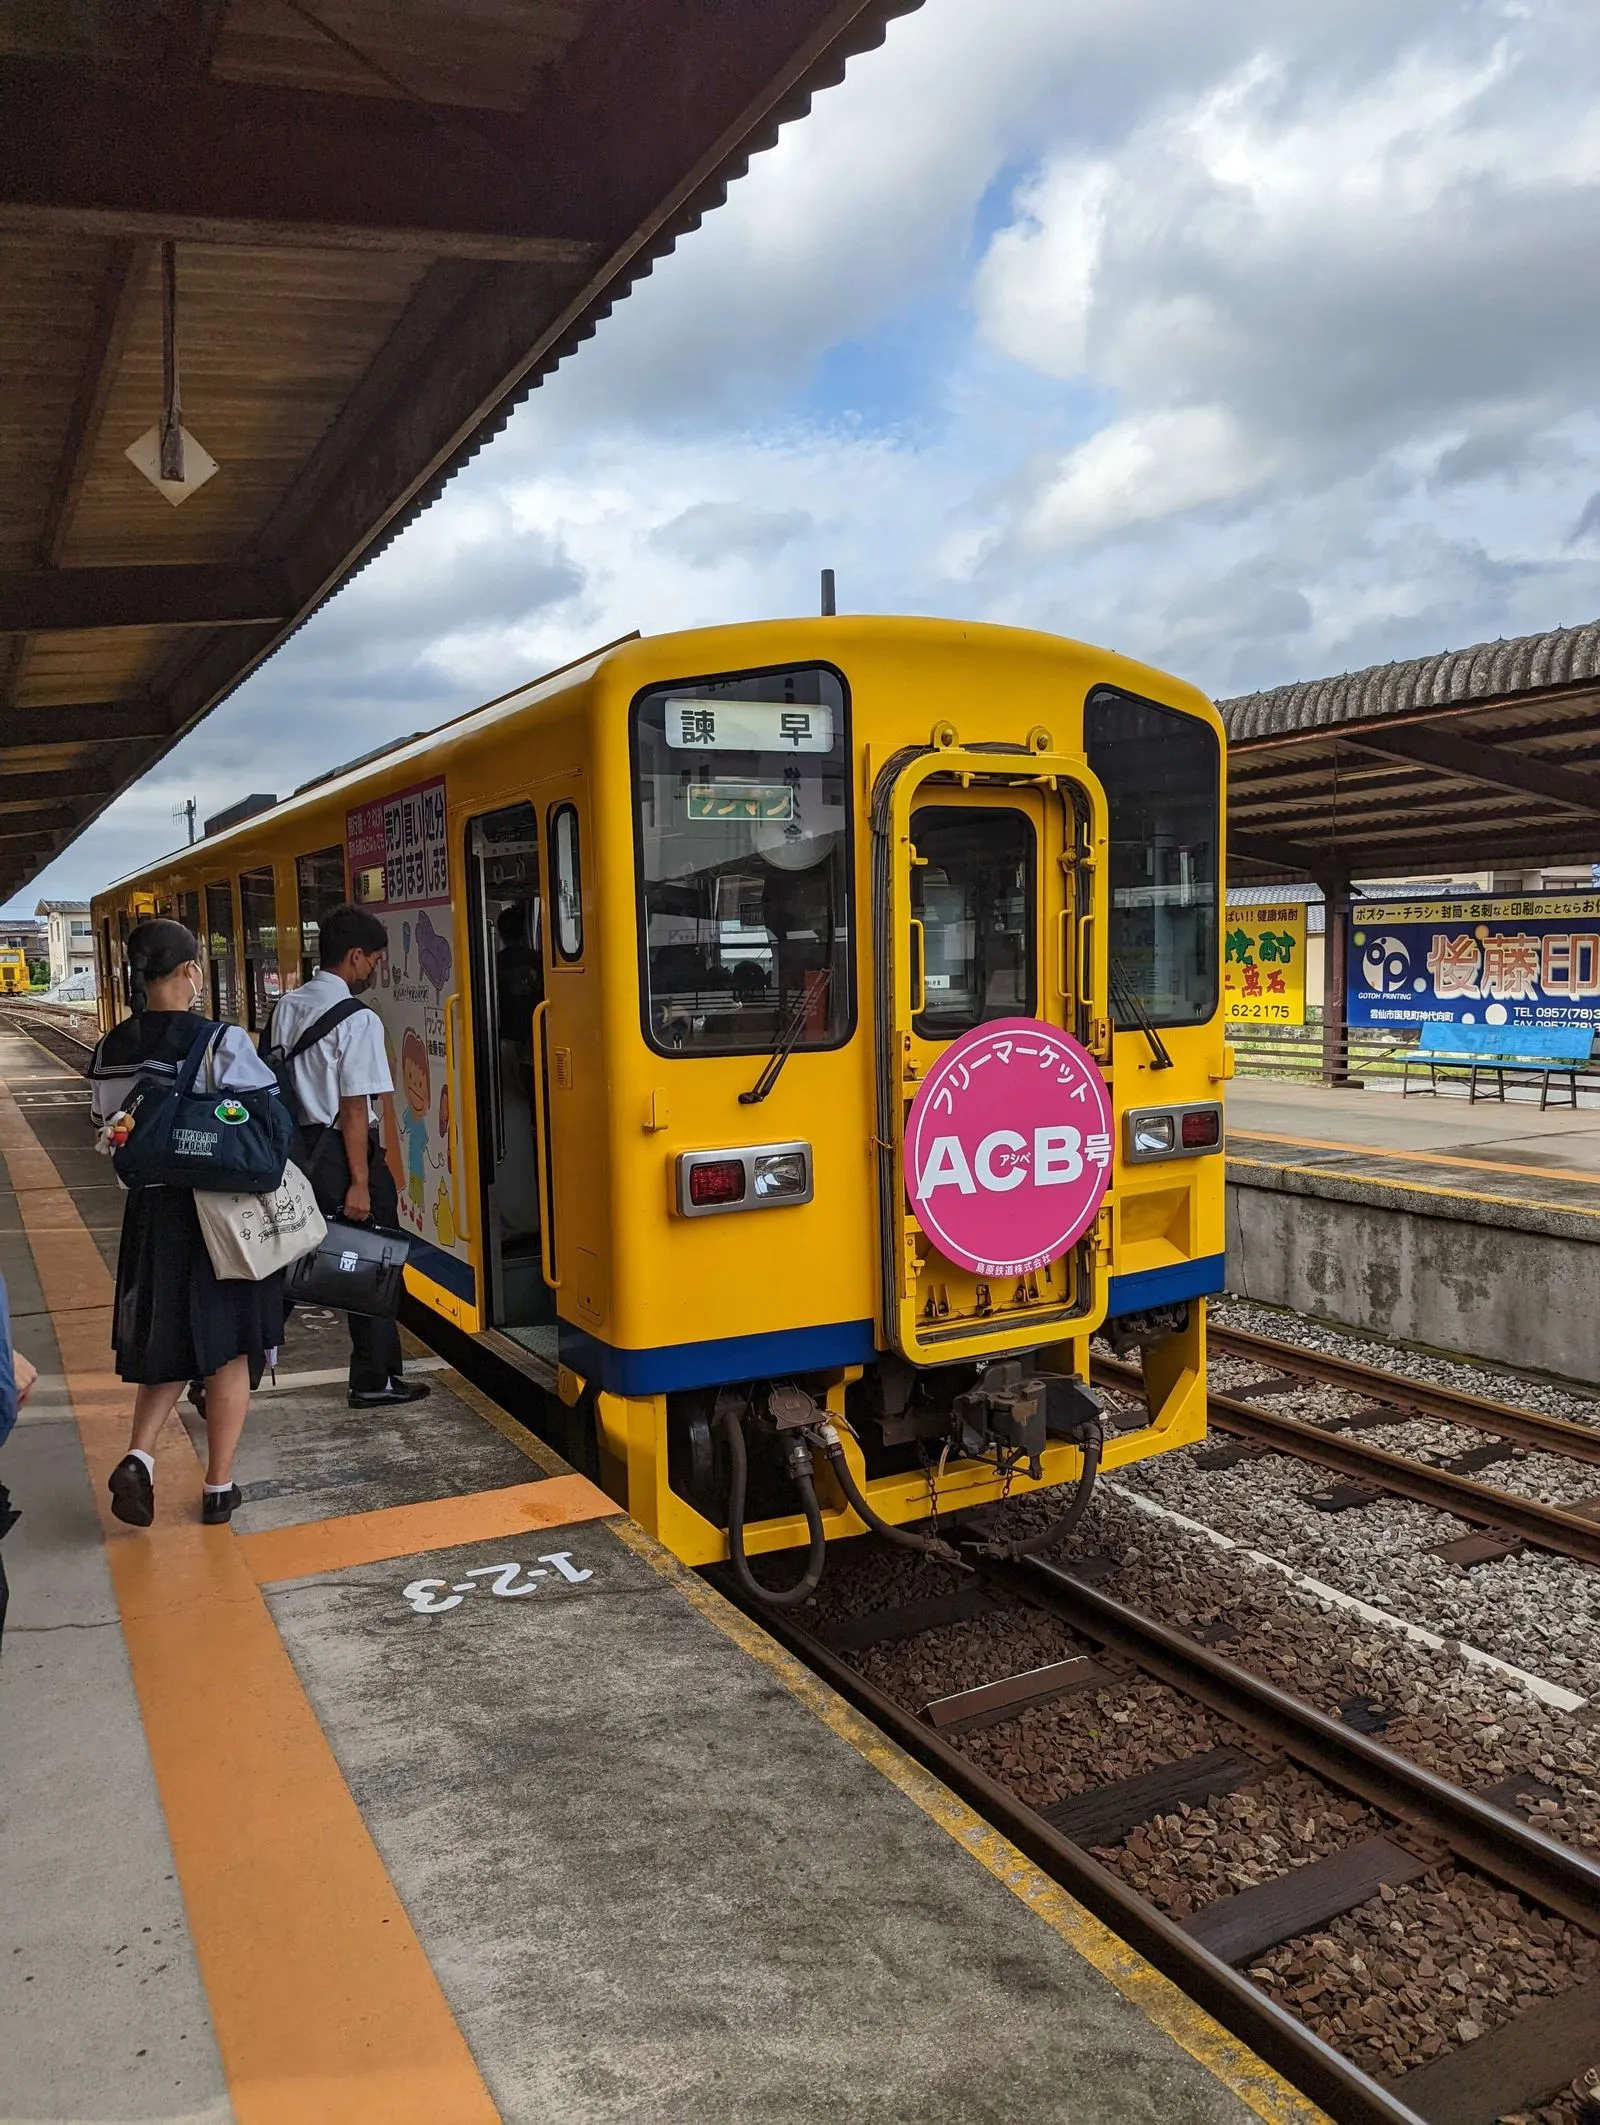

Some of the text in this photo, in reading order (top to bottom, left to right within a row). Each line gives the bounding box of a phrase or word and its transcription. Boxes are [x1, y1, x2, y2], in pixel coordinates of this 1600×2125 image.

[680, 709, 813, 747] 諫早
[1257, 908, 1298, 922] 健康焼酎
[1426, 932, 1600, 1002] 後藤印
[1358, 992, 1381, 1000] GOTOH
[1231, 1004, 1290, 1018] 62-2175
[1513, 1007, 1533, 1018] TEL
[933, 1041, 1088, 1115] フリーマーケット
[1000, 1152, 1031, 1167] アシベ
[975, 1253, 1052, 1277] 島原鉄道株式会社
[403, 1551, 594, 1613] 1-2-3
